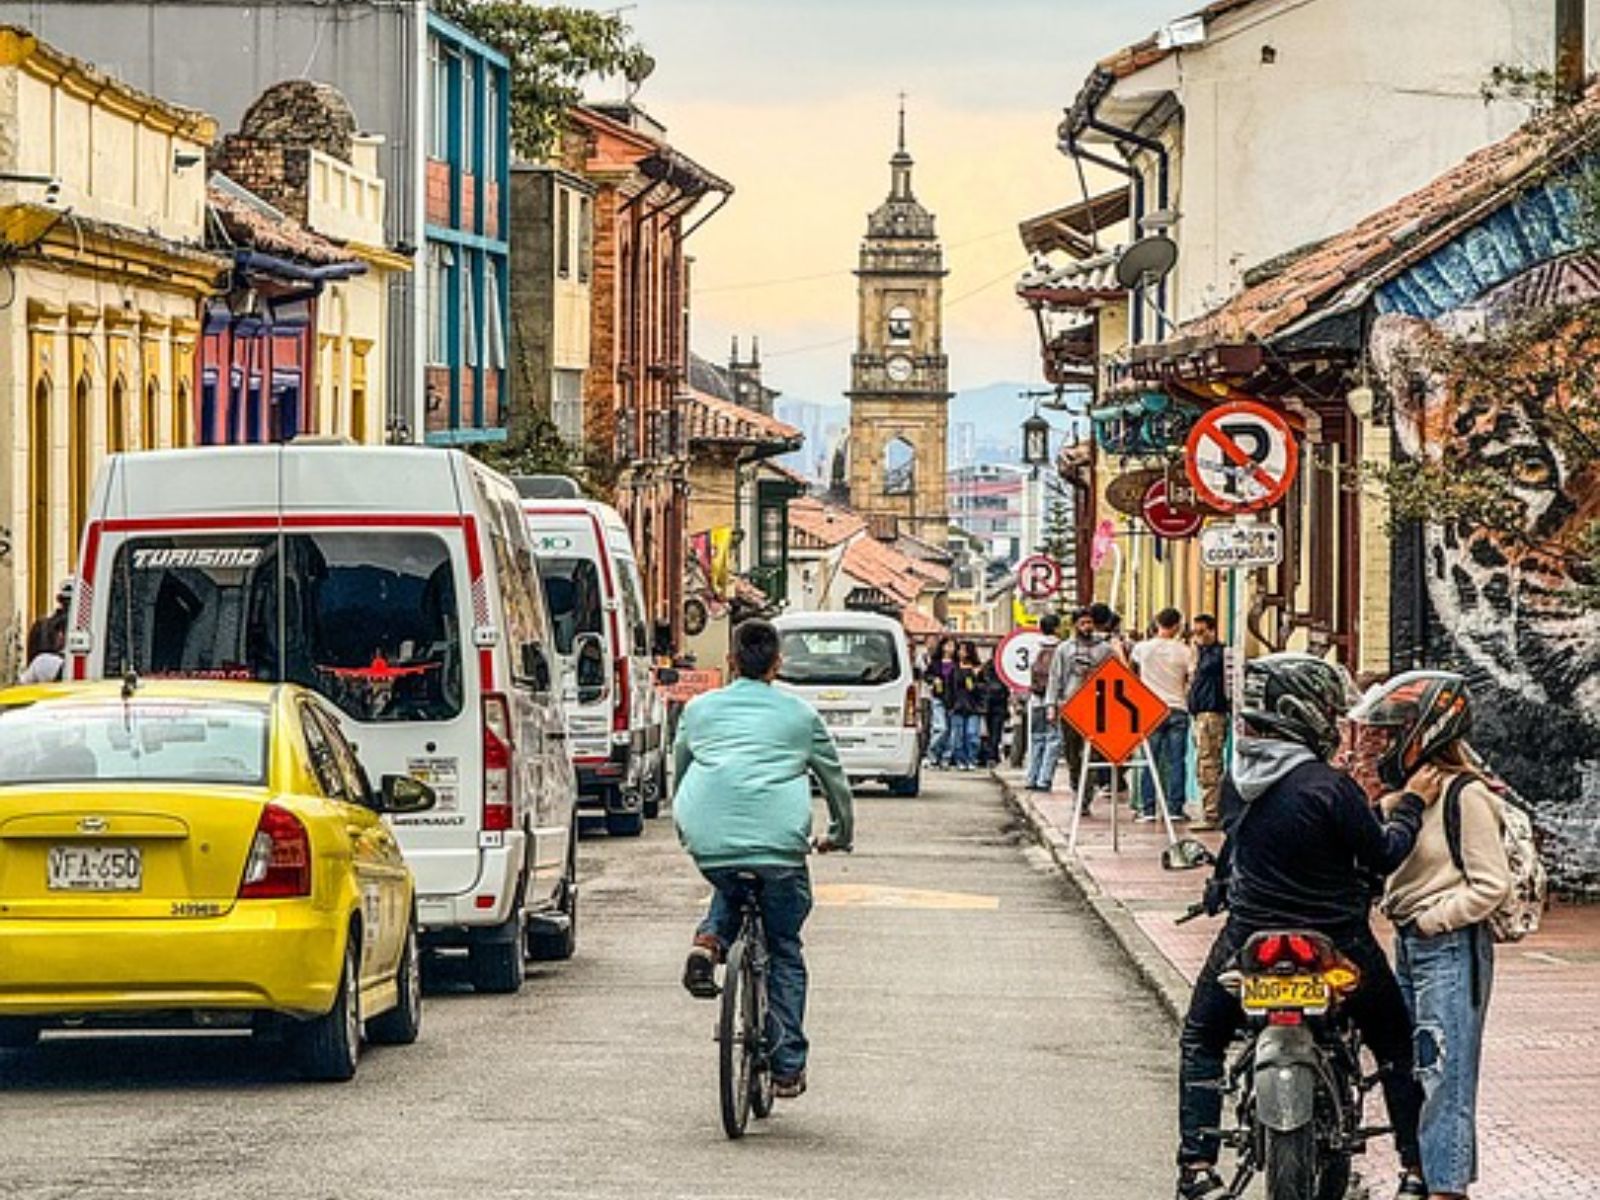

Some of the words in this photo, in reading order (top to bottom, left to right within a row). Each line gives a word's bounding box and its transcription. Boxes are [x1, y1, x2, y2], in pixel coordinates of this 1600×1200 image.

[132, 548, 263, 569] TURISMO
[1015, 647, 1030, 671] 3
[50, 852, 140, 880] VFA-650
